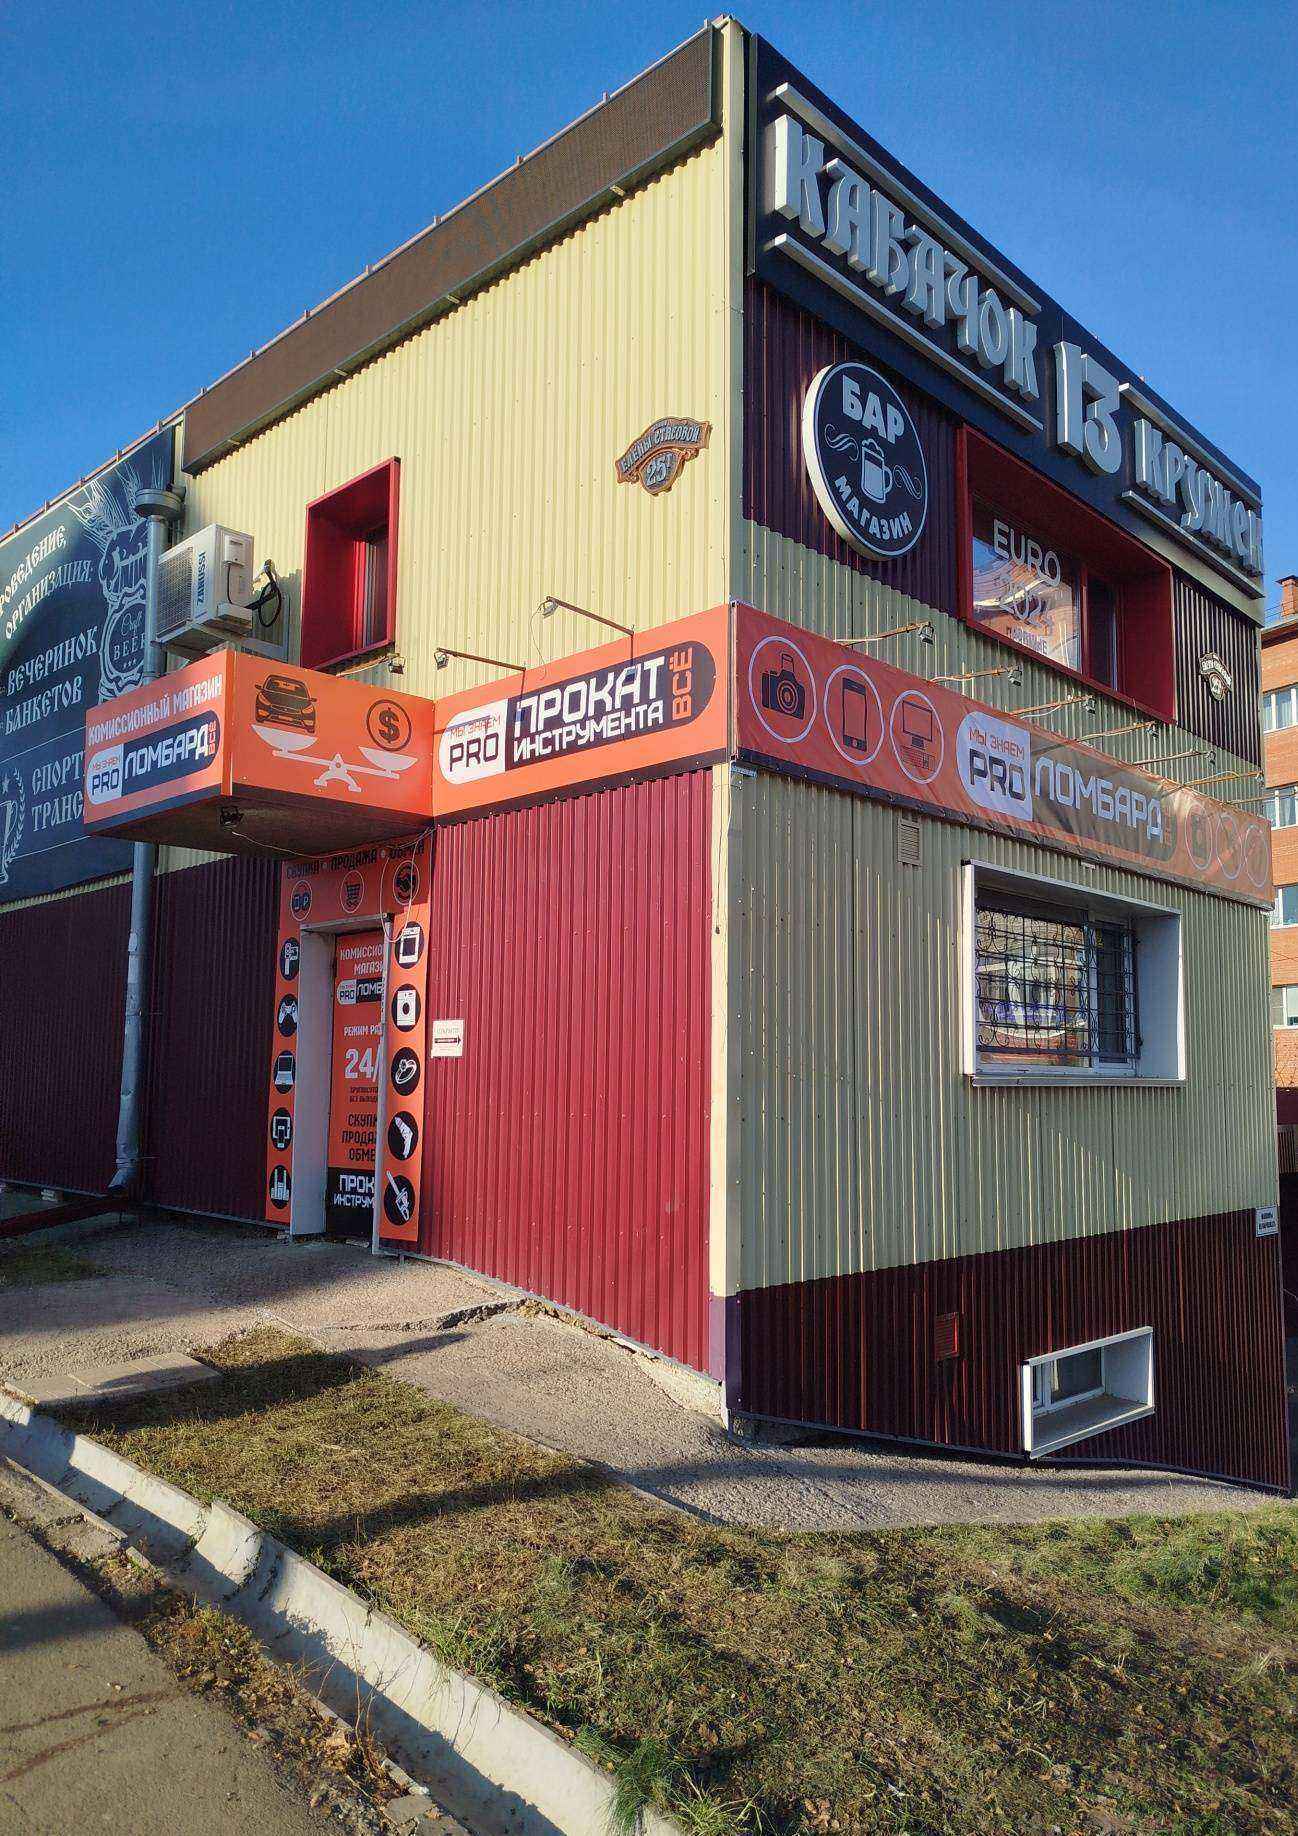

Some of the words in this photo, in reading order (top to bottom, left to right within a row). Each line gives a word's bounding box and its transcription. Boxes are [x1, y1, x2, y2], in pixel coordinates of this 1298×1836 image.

[775, 114, 1040, 400] КАБАЧОК
[1053, 340, 1122, 474] 13
[842, 374, 905, 445] БАР
[834, 475, 913, 541] МАГАЗИН
[196, 551, 206, 606] ZANUSSI
[993, 518, 1062, 588] EURO
[7, 625, 99, 697] ВЕЧЕРИНОК
[669, 647, 694, 721] ВСЁ
[4, 675, 83, 736] БАНКЕТОВ
[88, 693, 171, 747] КОМИССИОННЫЙ
[173, 674, 223, 715] МАГАЗИН
[514, 655, 666, 738] ПРОКАТ
[124, 723, 209, 780] ЛОМБАРД
[449, 732, 500, 772] PRO
[513, 700, 664, 763] ИНСТРУМЕНТА
[969, 727, 987, 746] МЫ
[990, 734, 1025, 761] ЗНАЕМ
[32, 750, 84, 796] СПОРТ
[92, 768, 120, 796] PRO
[969, 748, 1027, 801] PRO
[31, 790, 84, 833] ТРАНС
[1035, 756, 1164, 844] ЛОМБАРД
[340, 944, 384, 960] КОМИССИО
[354, 960, 384, 976] МАГАЗ
[357, 981, 383, 996] ЛОМБ
[344, 1047, 381, 1082] 24/
[341, 1130, 376, 1147] ПРОДА
[348, 1147, 376, 1161] ОБМЕ
[333, 1193, 375, 1208] ИНСТРУМ
[339, 1174, 375, 1193] ПРОК
